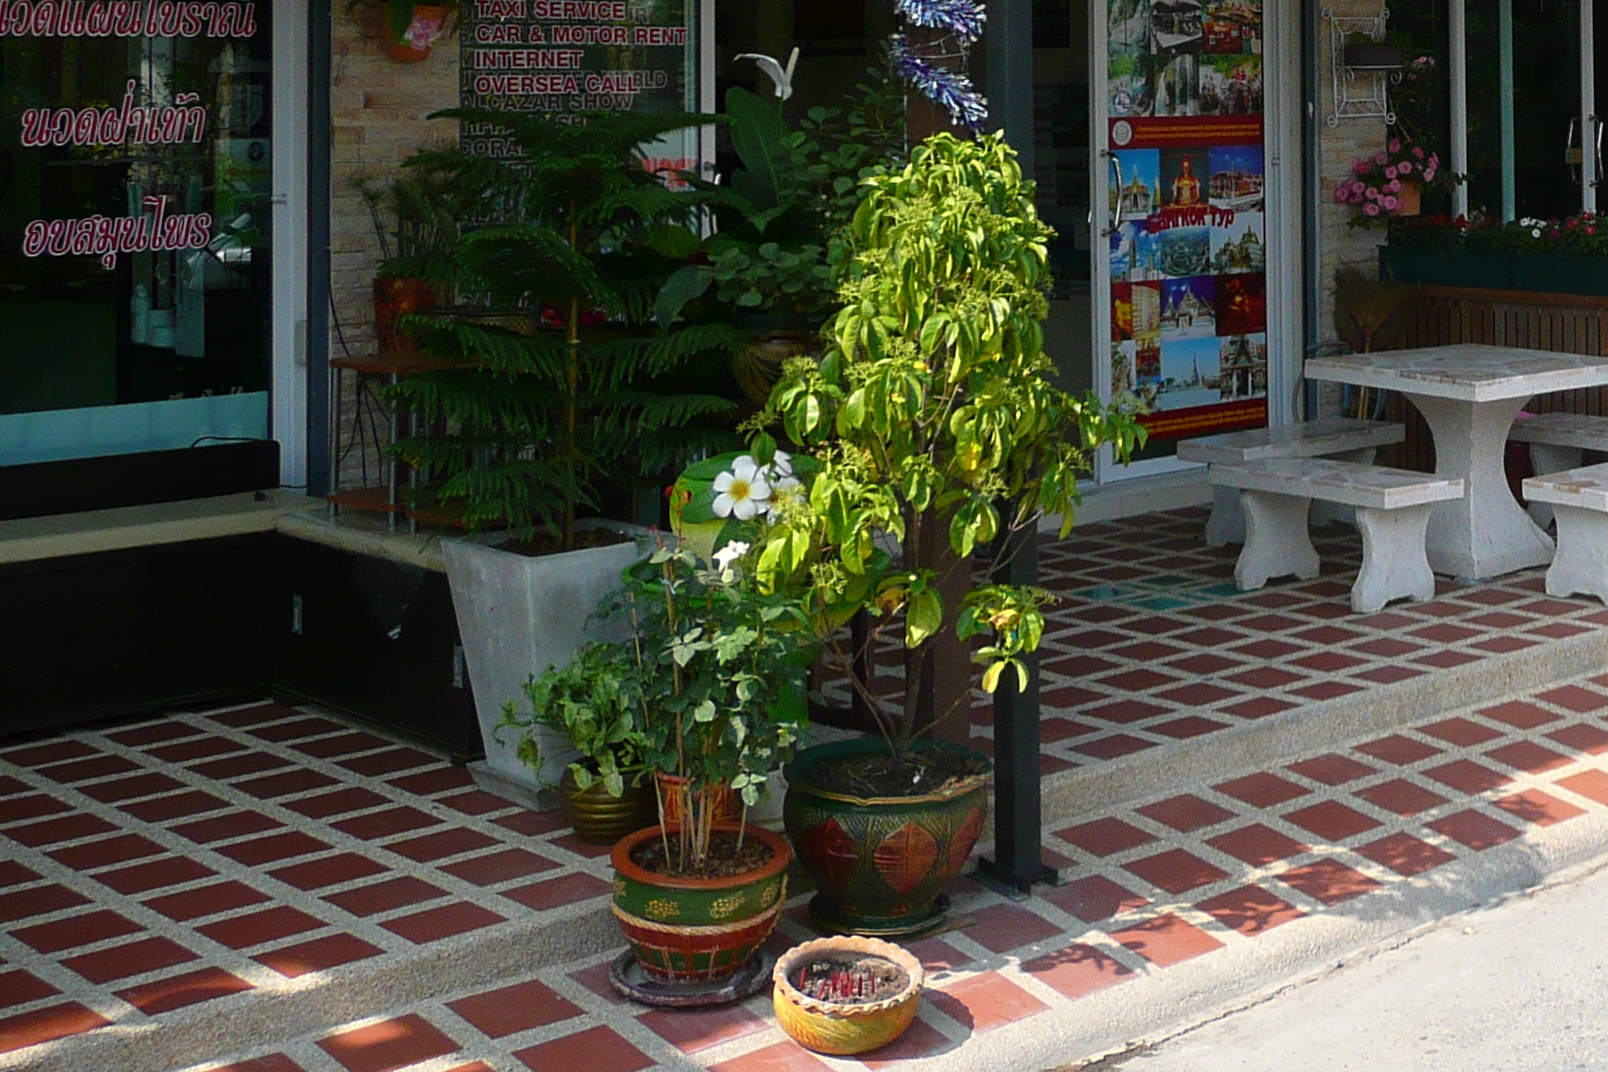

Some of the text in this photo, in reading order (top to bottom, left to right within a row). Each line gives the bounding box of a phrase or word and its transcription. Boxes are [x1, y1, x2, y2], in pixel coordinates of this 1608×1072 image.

[475, 0, 527, 18] TAXI
[535, 0, 626, 20] SERVICE
[475, 25, 687, 46] CAR & MOTOR RENT
[474, 49, 585, 69] INTERNET
[474, 75, 578, 95] OVERSEA
[585, 77, 641, 94] CALL
[21, 79, 206, 146] นวดฝ่าเท้า
[569, 94, 635, 111] SHOW
[23, 195, 212, 269] อบสมุนไพร
